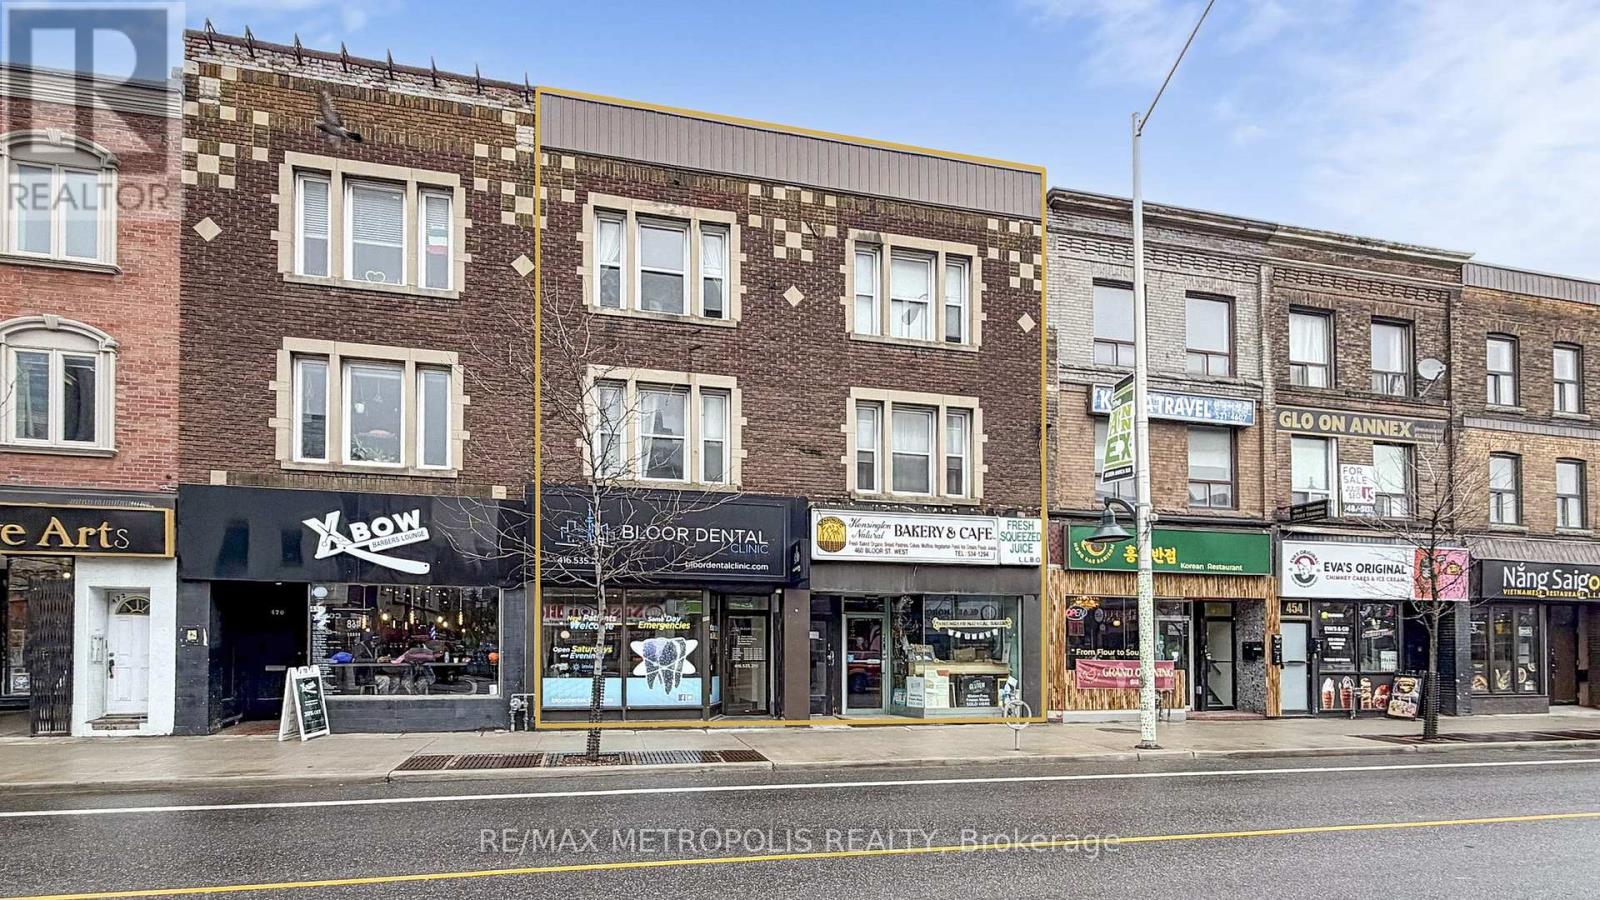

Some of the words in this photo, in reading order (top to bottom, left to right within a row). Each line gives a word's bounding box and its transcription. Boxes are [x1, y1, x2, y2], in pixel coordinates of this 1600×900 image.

[1156, 396, 1211, 418] TRAVEL
[1279, 411, 1313, 429] GLO
[1319, 414, 1345, 432] ON
[1350, 417, 1412, 438] ANNEX
[1343, 467, 1363, 475] FOR
[1343, 476, 1367, 484] SALE
[849, 517, 891, 529] Kensington
[1007, 520, 1034, 530] FRESH
[0, 524, 26, 546] e
[36, 516, 130, 549] Arts
[622, 524, 689, 541] BLOOR
[696, 528, 769, 545] DENTAL
[851, 529, 886, 539] Natural
[894, 524, 944, 538] BAKERY
[946, 526, 956, 539] &
[959, 527, 993, 541] CAFE
[1000, 531, 1041, 542] SQUEEZED
[372, 536, 400, 549] BARBERS
[401, 531, 426, 542] LOUNGE
[730, 543, 769, 555] CLINIC
[1010, 543, 1033, 553] JUICE
[1123, 544, 1176, 564] 홍반점
[685, 561, 769, 570] bloordentalclinic.com
[1180, 562, 1204, 570] Korean
[1207, 563, 1243, 571] Restaurant
[1324, 562, 1352, 573] EVA'S
[1355, 563, 1407, 574] ORIGINAL
[1503, 562, 1550, 597] Nắng
[1286, 602, 1303, 613] 454
[665, 615, 682, 623] Day
[570, 621, 615, 630] Welcoe
[638, 621, 691, 631] Emergencies
[571, 645, 613, 654] Saturys
[1102, 668, 1133, 677] GRAND
[1135, 667, 1174, 678] ONING
